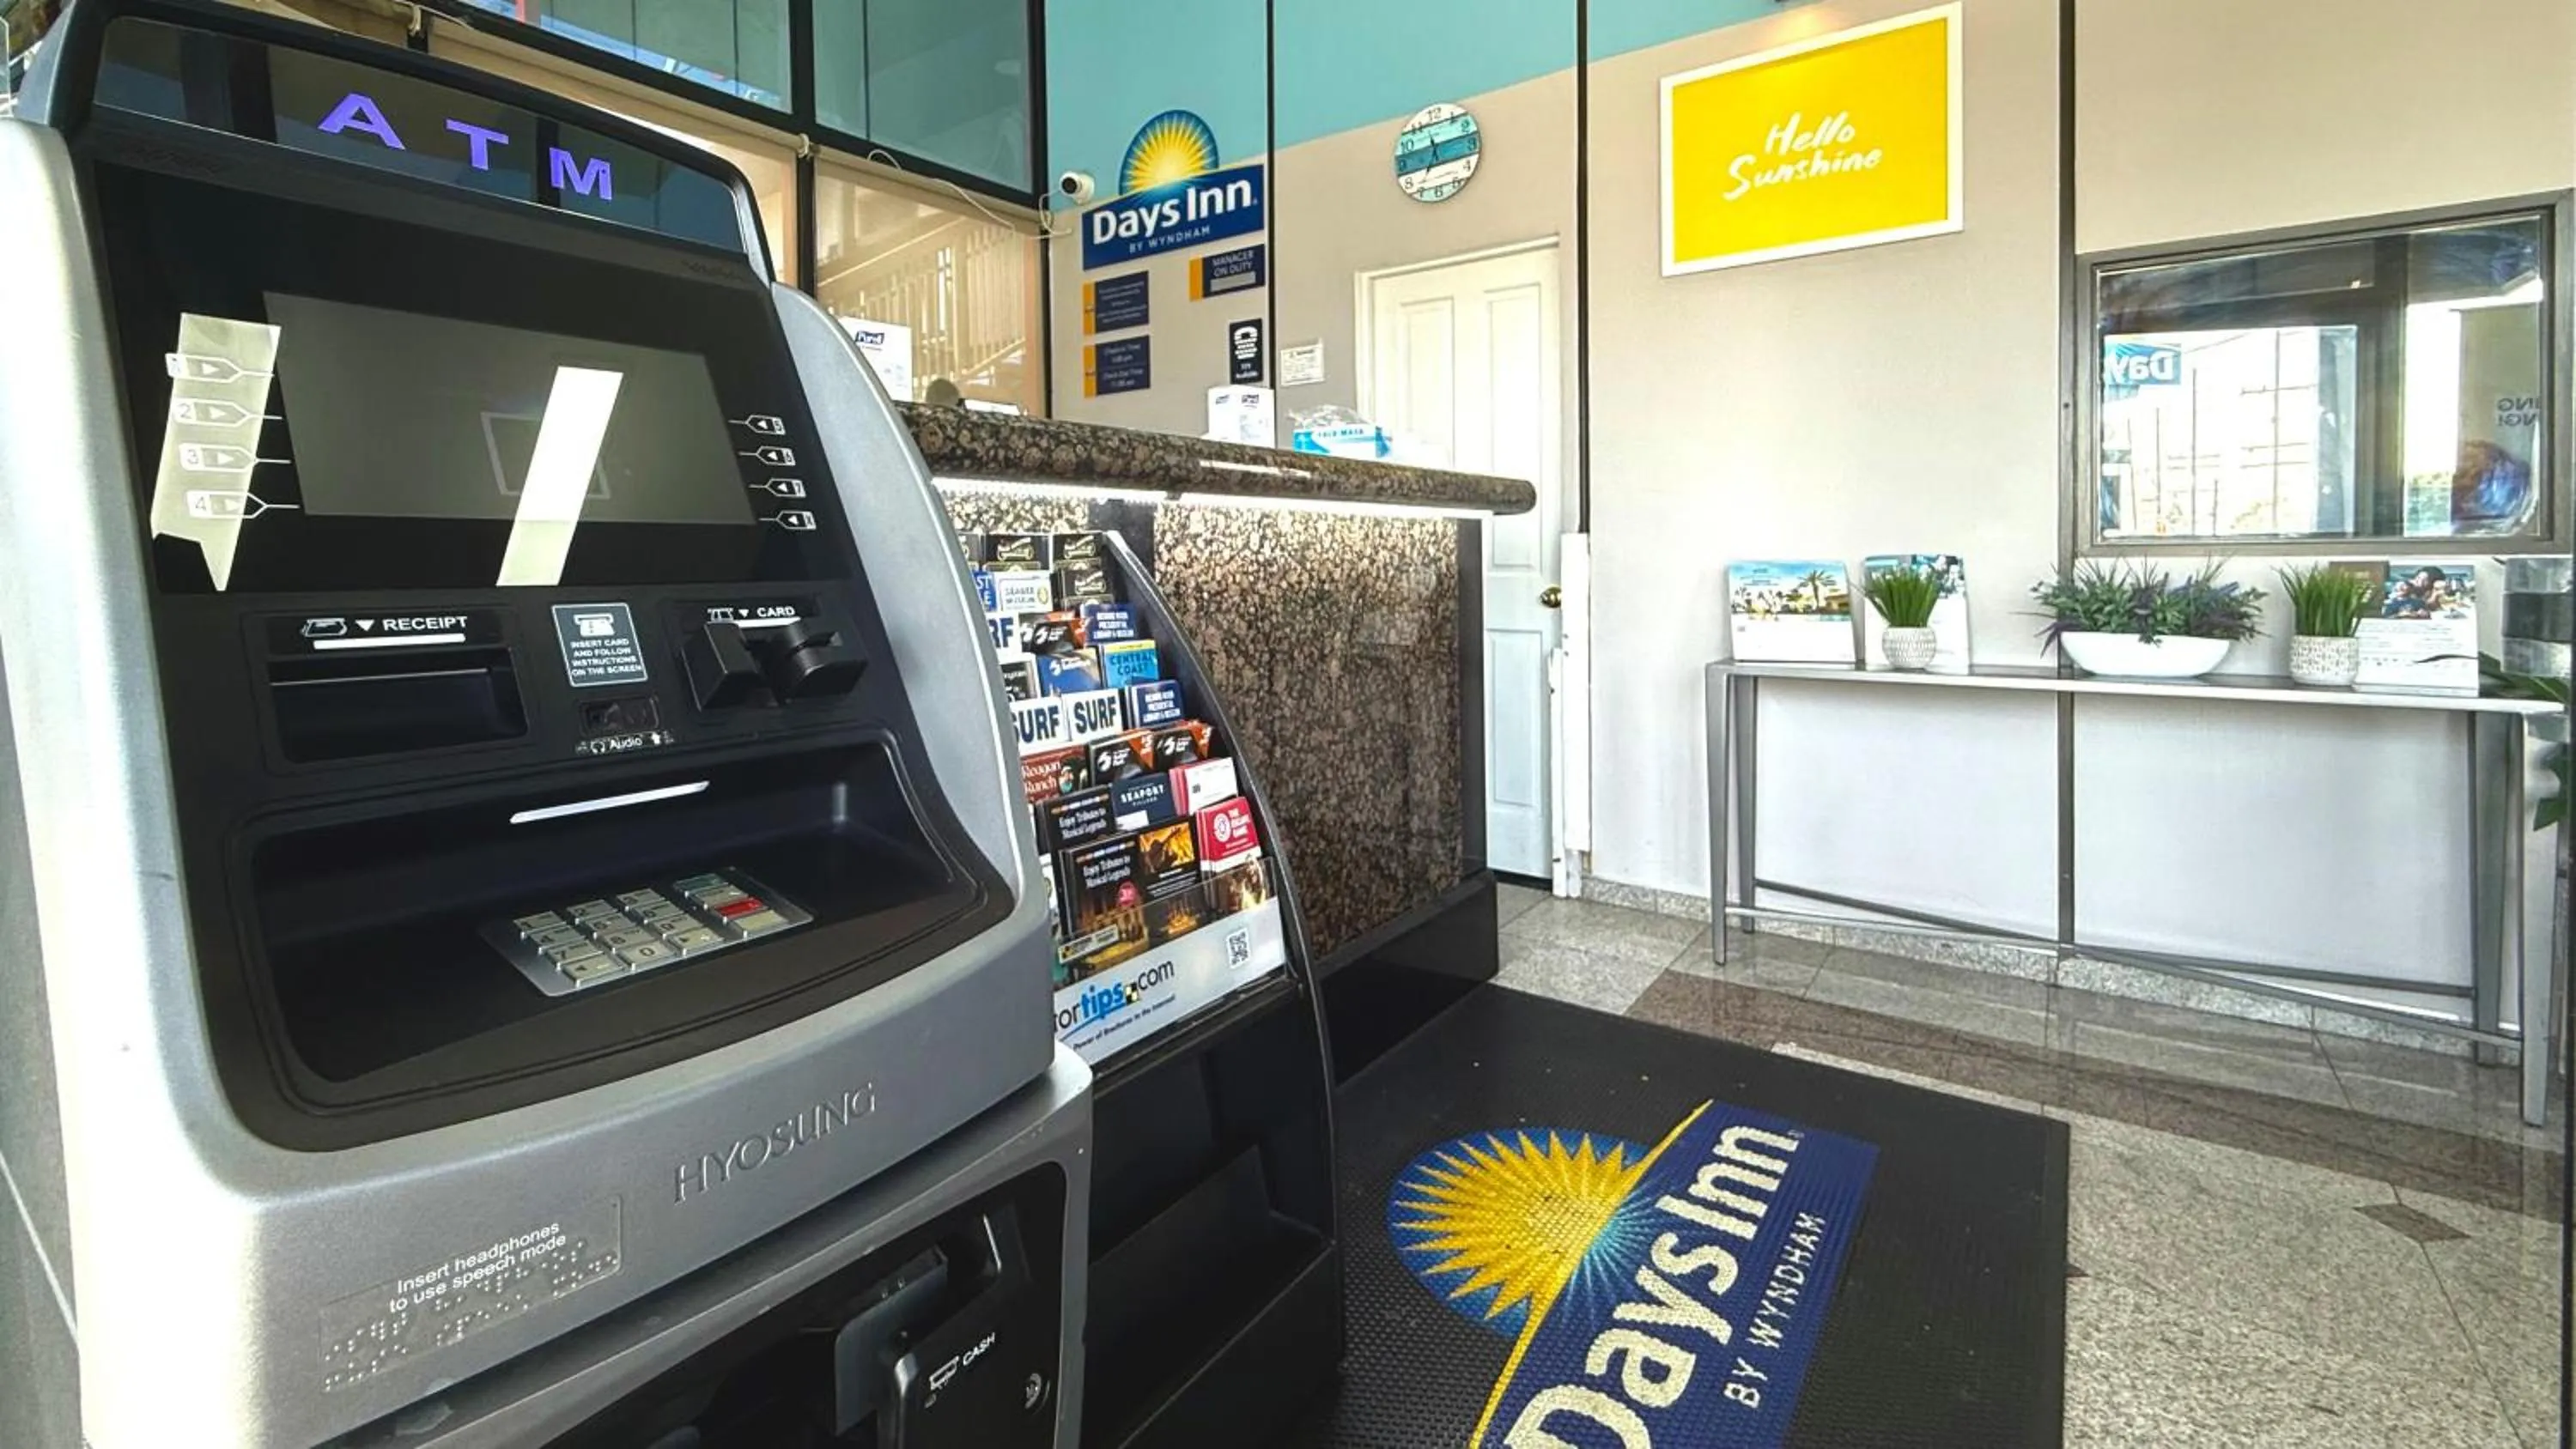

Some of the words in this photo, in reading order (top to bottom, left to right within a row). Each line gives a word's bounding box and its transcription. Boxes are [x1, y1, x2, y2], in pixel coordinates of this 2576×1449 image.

[1428, 107, 1442, 121] 12
[1765, 111, 1856, 156] Hello
[318, 93, 612, 200] ATM
[1401, 138, 1414, 155] 10
[1405, 177, 1414, 189] 8
[1722, 148, 1883, 202] Sunshine
[1435, 185, 1443, 197] 6
[1093, 198, 1181, 245] Days
[1187, 179, 1252, 221] Inn
[1129, 243, 1144, 254] BY
[1148, 226, 1211, 249] WYNDHAM
[1212, 250, 1254, 266] MANAGER
[1214, 267, 1227, 277] ON
[1229, 261, 1252, 274] DUTY
[756, 606, 796, 617] CARD
[382, 615, 468, 632] RECEIPT
[570, 640, 601, 649] INSERT
[594, 647, 631, 657] FOLLOW
[571, 655, 637, 666] INSTRUCTIONS
[1110, 651, 1157, 665] CENTRAL
[606, 664, 642, 674] SCREEN
[1117, 663, 1148, 676] COAST
[1074, 696, 1116, 734] SURF
[609, 737, 642, 749] Audio
[1121, 785, 1165, 803] SEAPORT
[674, 1082, 875, 1206] HYOSUNG
[398, 1263, 450, 1294] Insert
[455, 1223, 560, 1272] headphones
[390, 1297, 408, 1313] to
[414, 1282, 447, 1305] use
[453, 1254, 515, 1288] speech
[520, 1235, 566, 1262] mode
[1504, 1233, 1738, 1449] Days
[1656, 1125, 1800, 1240] Inn
[1724, 1358, 1768, 1408] BY
[1747, 1211, 1826, 1349] WYNDHAM
[963, 1331, 995, 1366] CASH
